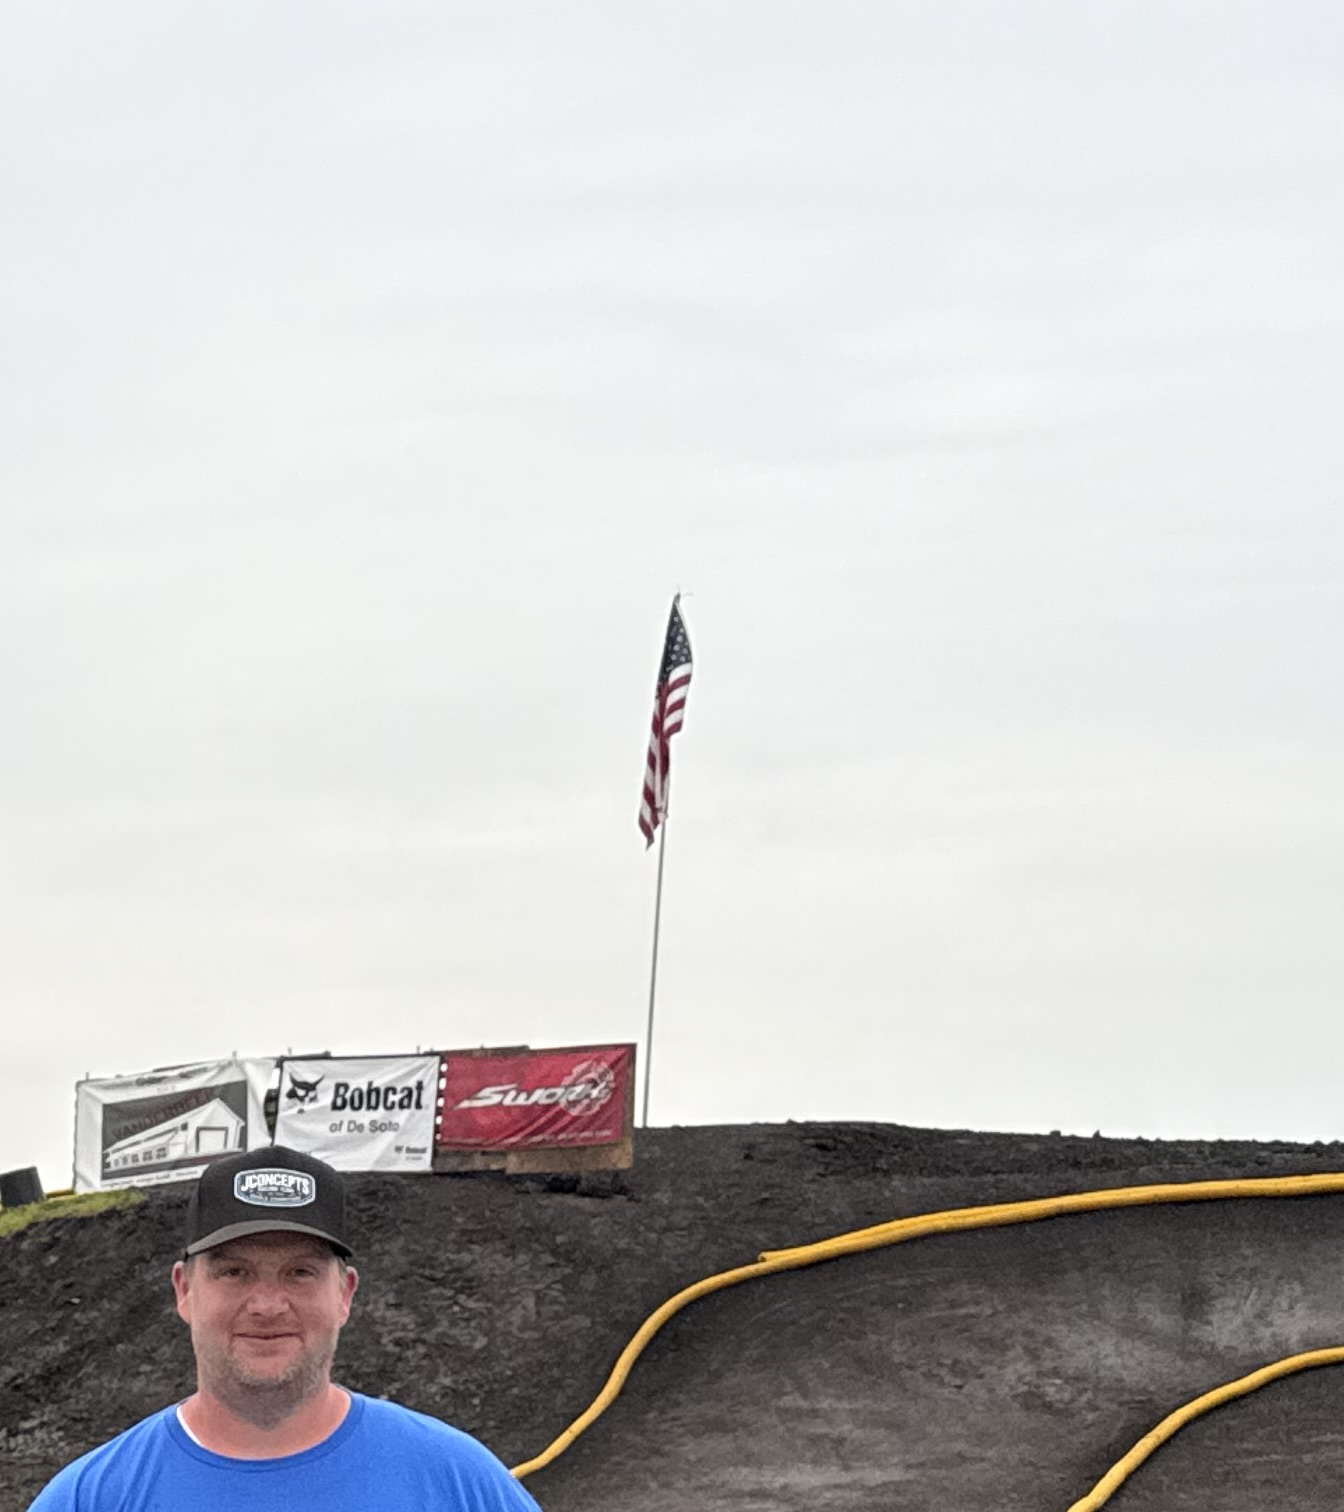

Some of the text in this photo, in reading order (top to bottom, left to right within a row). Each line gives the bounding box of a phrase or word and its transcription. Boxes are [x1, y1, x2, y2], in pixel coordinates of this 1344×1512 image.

[330, 1080, 423, 1112] Bobcat
[329, 1119, 400, 1133] of De Soto
[240, 1174, 310, 1195] JCONCEPTS
